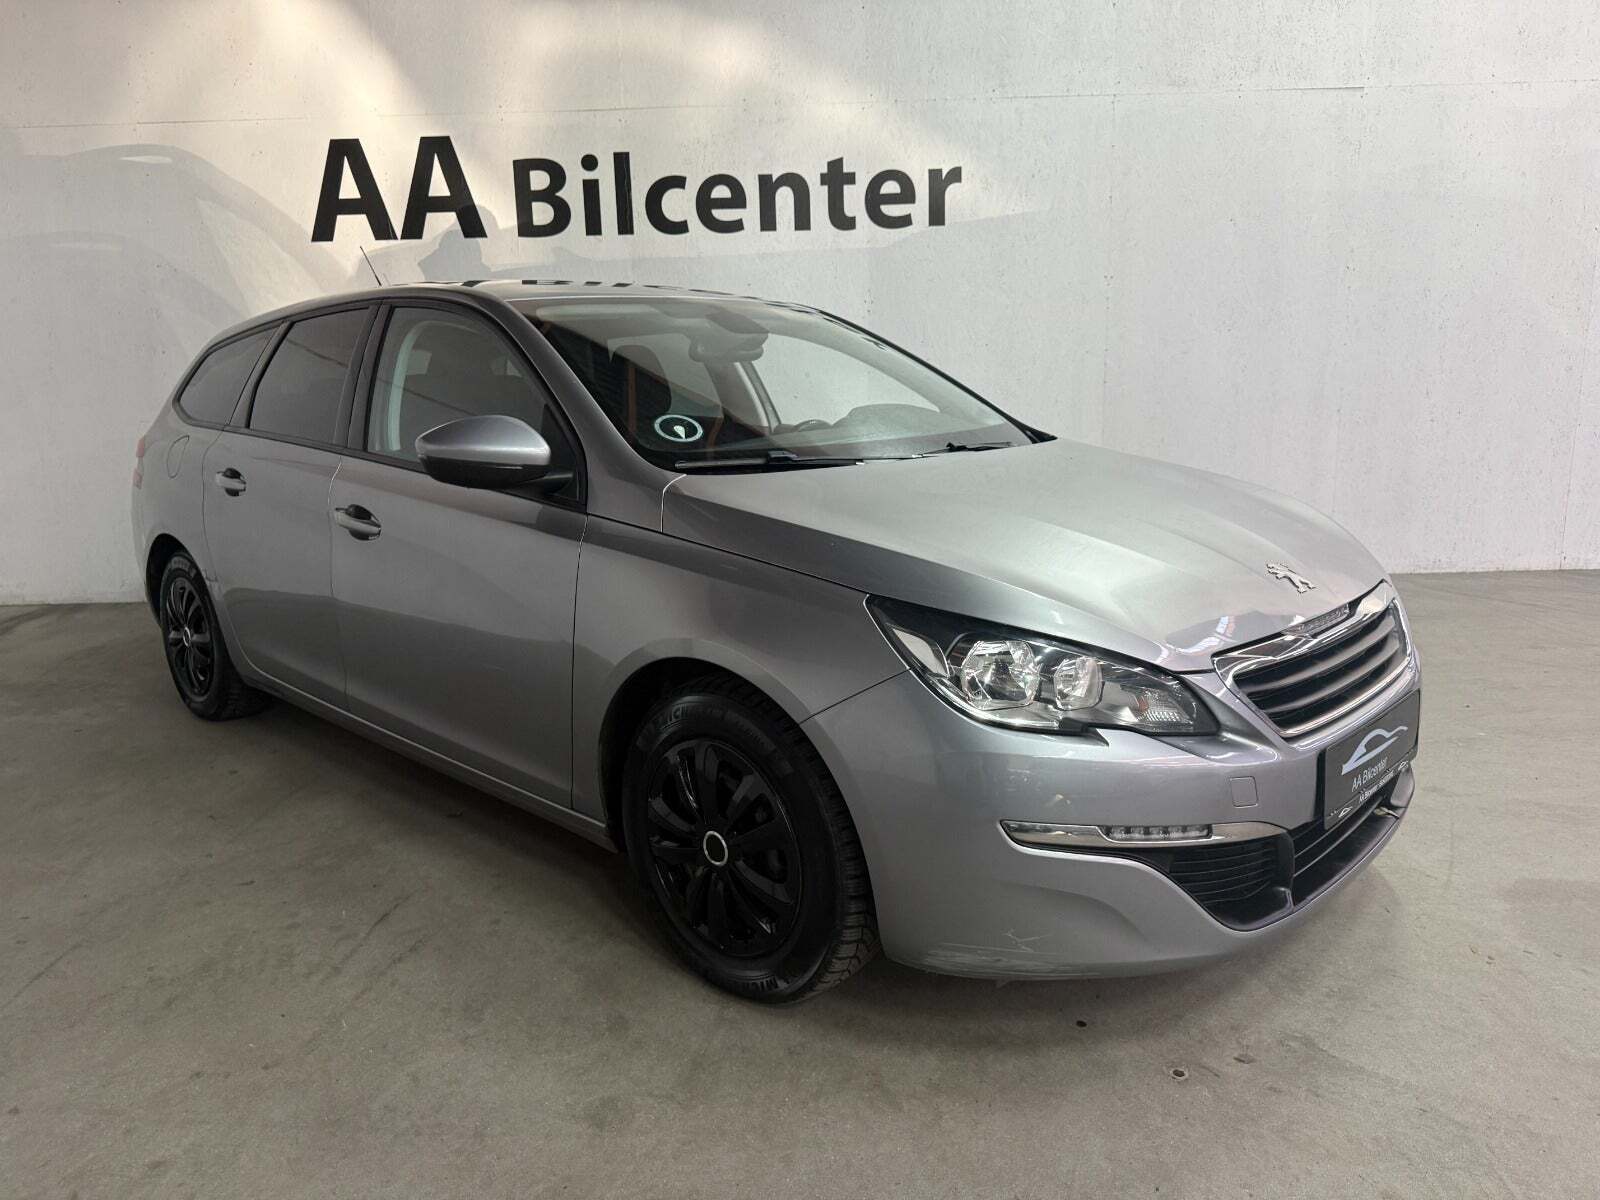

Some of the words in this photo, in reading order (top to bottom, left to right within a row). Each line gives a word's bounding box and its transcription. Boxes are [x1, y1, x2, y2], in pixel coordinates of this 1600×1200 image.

[312, 136, 487, 241] AA
[513, 151, 963, 237] Bilcenter
[1352, 774, 1362, 792] AA
[1362, 756, 1388, 784] Bilcenter
